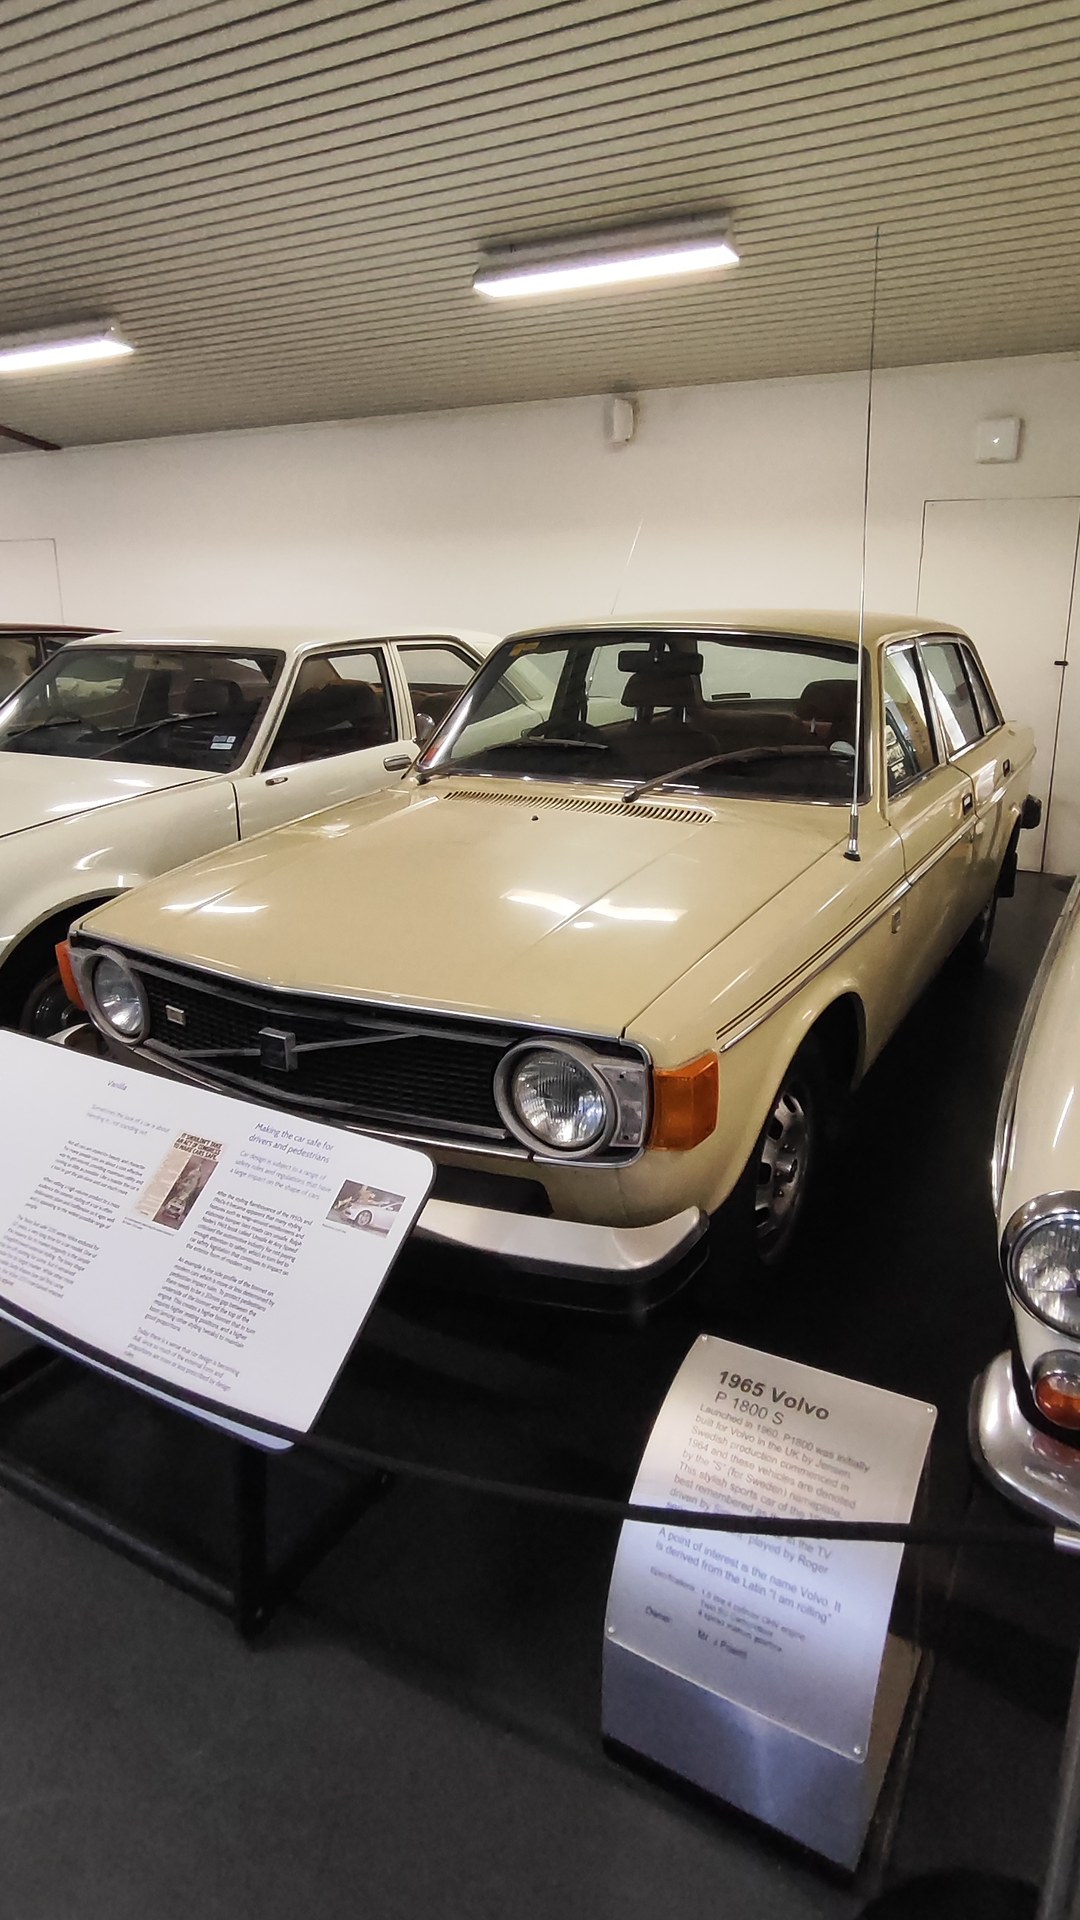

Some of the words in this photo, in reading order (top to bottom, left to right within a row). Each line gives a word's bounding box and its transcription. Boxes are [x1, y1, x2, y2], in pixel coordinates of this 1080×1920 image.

[249, 1134, 272, 1147] drivers
[273, 1143, 288, 1151] and
[287, 1146, 329, 1163] pedestrians
[255, 1123, 280, 1138] Making
[282, 1130, 293, 1139] the
[307, 1138, 321, 1148] safe
[323, 1141, 334, 1151] for
[715, 1391, 727, 1403] P
[733, 1398, 768, 1419] 1800
[772, 1411, 784, 1425] S
[720, 1371, 766, 1397] 1965
[772, 1387, 829, 1420] Volvo
[691, 1426, 727, 1446] Swedish
[730, 1441, 778, 1464] production
[780, 1460, 838, 1488] commenced
[841, 1481, 850, 1492] in
[695, 1415, 713, 1427] built
[716, 1420, 728, 1431] for
[730, 1427, 756, 1442] Volvo
[758, 1438, 765, 1446] in
[768, 1441, 782, 1452] the
[785, 1448, 799, 1459] UK
[802, 1454, 813, 1466] by
[700, 1404, 743, 1425] Launched
[783, 1433, 814, 1451] P1800
[815, 1448, 834, 1459] was
[837, 1454, 870, 1472] initially
[674, 1473, 692, 1486] best
[695, 1483, 754, 1512] remembered
[680, 1461, 696, 1476] This
[699, 1468, 727, 1489] stylish
[730, 1482, 758, 1500] sports
[760, 1494, 776, 1507] car
[778, 1501, 789, 1512] of
[790, 1505, 805, 1519] the
[682, 1449, 693, 1461] by
[695, 1453, 710, 1466] the
[727, 1466, 743, 1479] (for
[746, 1474, 787, 1497] Sweden)
[689, 1437, 709, 1452] 1964
[711, 1448, 728, 1459] and
[730, 1454, 755, 1470] these
[758, 1464, 795, 1486] vehicles
[797, 1481, 813, 1493] are
[816, 1487, 856, 1509] denoted
[669, 1487, 698, 1505] driven
[700, 1499, 710, 1510] by
[799, 1538, 813, 1553] the
[818, 1545, 831, 1560] TV
[656, 1541, 663, 1552] is
[665, 1545, 700, 1567] derived
[701, 1560, 723, 1578] from
[725, 1571, 740, 1584] the
[742, 1578, 767, 1596] Latin
[778, 1595, 794, 1608] am
[659, 1527, 666, 1537] A
[667, 1531, 690, 1549] point
[693, 1542, 703, 1552] of
[704, 1547, 740, 1569] interest
[741, 1563, 749, 1572] is
[752, 1566, 767, 1581] the
[769, 1575, 797, 1593] name
[748, 1535, 781, 1556] played
[783, 1549, 796, 1564] by
[797, 1554, 829, 1574] Roger
